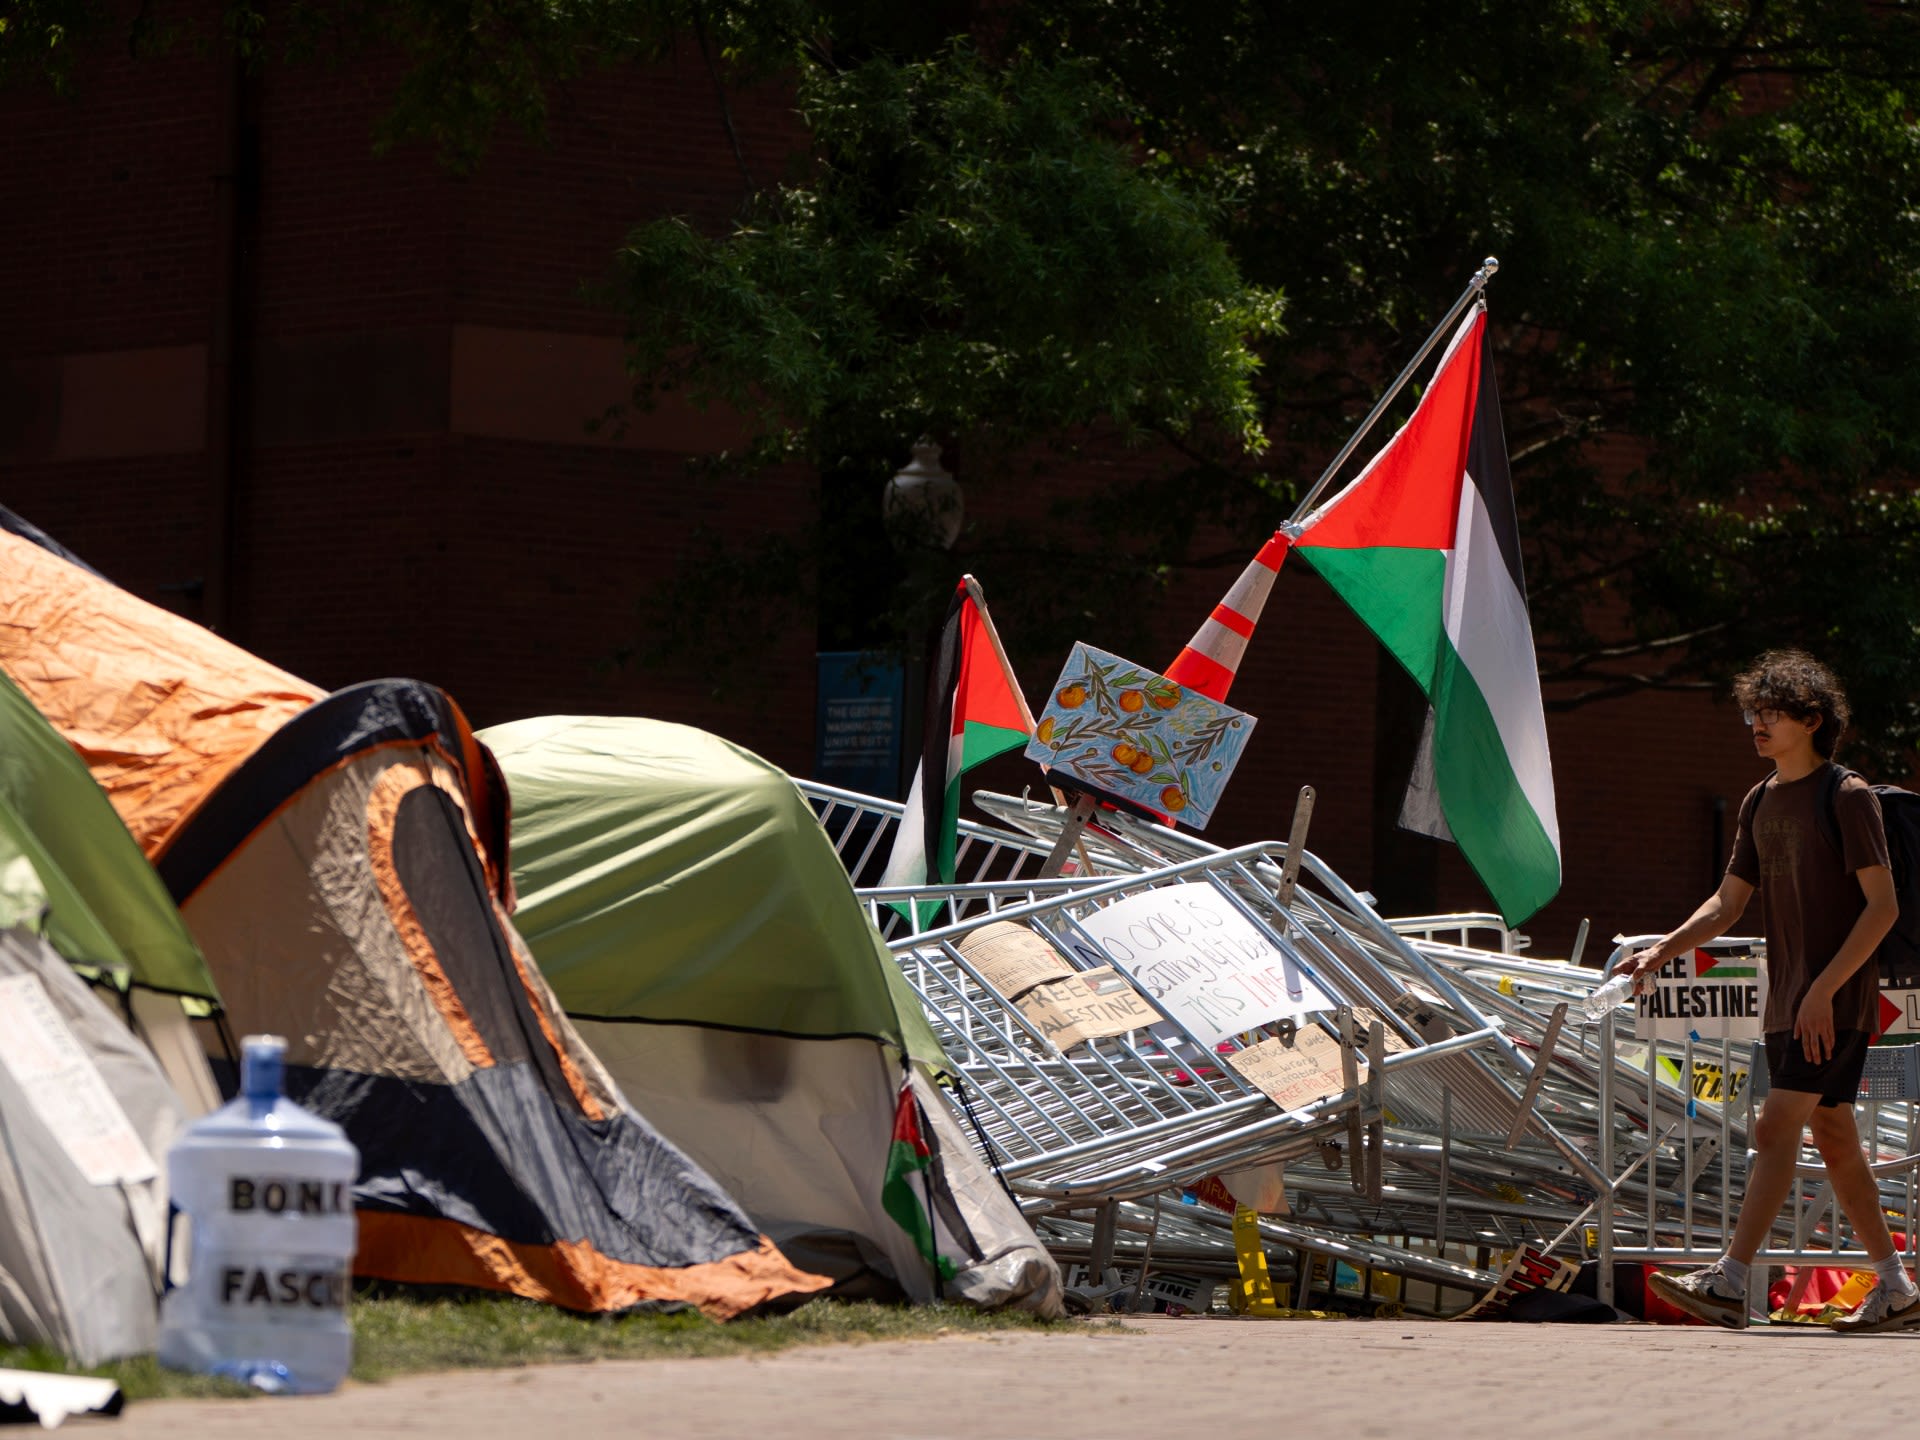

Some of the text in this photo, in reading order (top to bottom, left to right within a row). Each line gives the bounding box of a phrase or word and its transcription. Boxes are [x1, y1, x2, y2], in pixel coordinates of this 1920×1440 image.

[1015, 978, 1088, 1017] FREE
[1036, 992, 1148, 1038] ALESTINE
[1640, 985, 1759, 1018] PALESTINE
[1280, 1056, 1319, 1073] wrong
